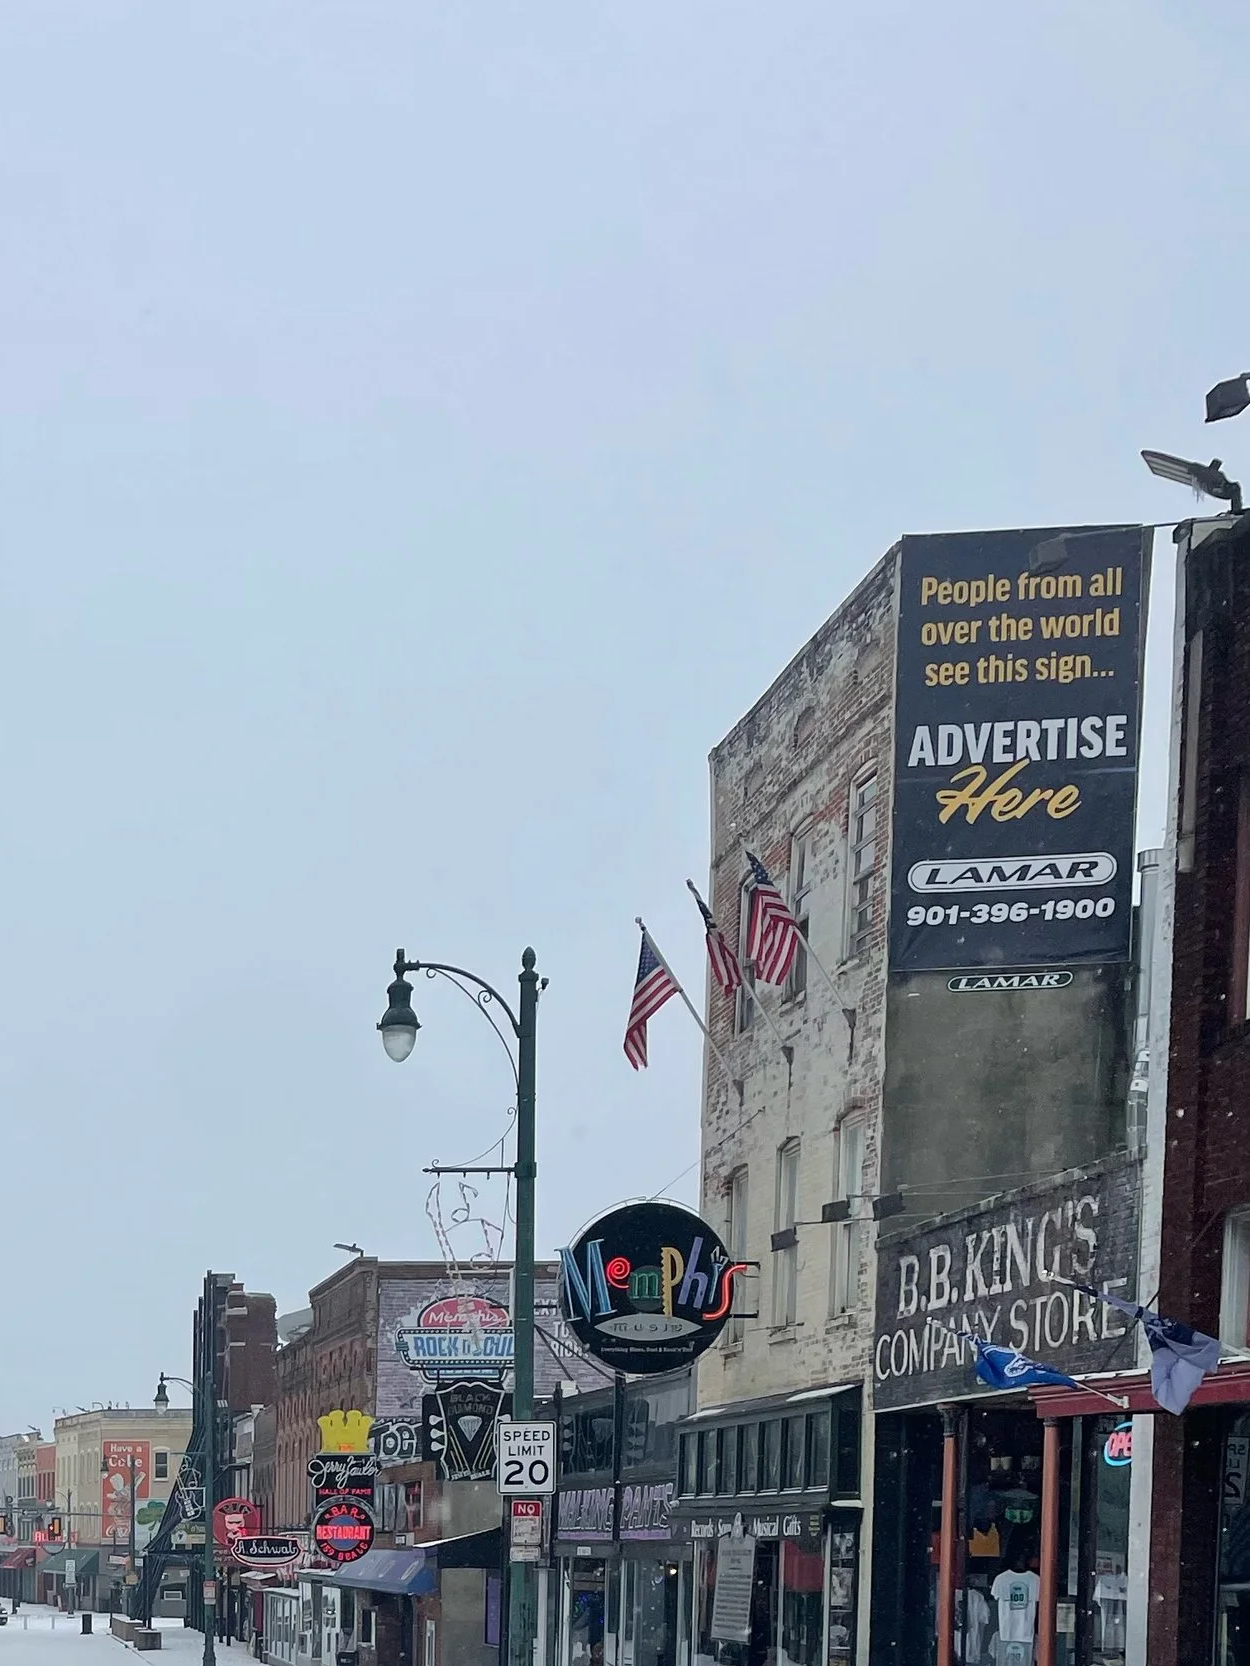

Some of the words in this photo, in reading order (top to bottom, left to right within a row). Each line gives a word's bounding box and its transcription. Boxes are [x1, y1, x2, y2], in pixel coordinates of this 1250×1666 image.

[921, 574, 1010, 607] People
[1017, 572, 1083, 600] from
[1089, 567, 1123, 596] all
[921, 620, 982, 646] over
[989, 613, 1033, 642] the
[1040, 608, 1120, 640] world
[924, 661, 970, 687] see
[977, 654, 1028, 683] this
[1035, 652, 1114, 684] sign...
[908, 715, 1127, 767] ADVERTISE
[936, 758, 1082, 824] Here
[925, 860, 1099, 885] LAMAR
[907, 897, 1115, 926] 901-396-1900
[958, 974, 1060, 989] LAMAR
[554, 1236, 748, 1323] Memphis
[534, 1299, 558, 1316] EXT
[875, 1305, 1001, 1381] COMPANY
[1009, 1276, 1128, 1352] STORE
[413, 1336, 459, 1357] ROCK
[503, 1431, 550, 1441] SPEED
[1109, 1431, 1132, 1457] OPE
[110, 1444, 132, 1453] Have
[508, 1446, 545, 1456] LIMIT
[109, 1454, 143, 1468] Coe
[504, 1460, 549, 1485] 20
[308, 1459, 346, 1488] Jerry
[330, 1505, 360, 1519] BAR
[517, 1505, 535, 1514] NO
[316, 1525, 371, 1540] RESTAURANT
[691, 1518, 714, 1538] Records
[753, 1515, 779, 1537] Musical
[783, 1515, 801, 1537] Gifts
[249, 1539, 297, 1555] Schwab
